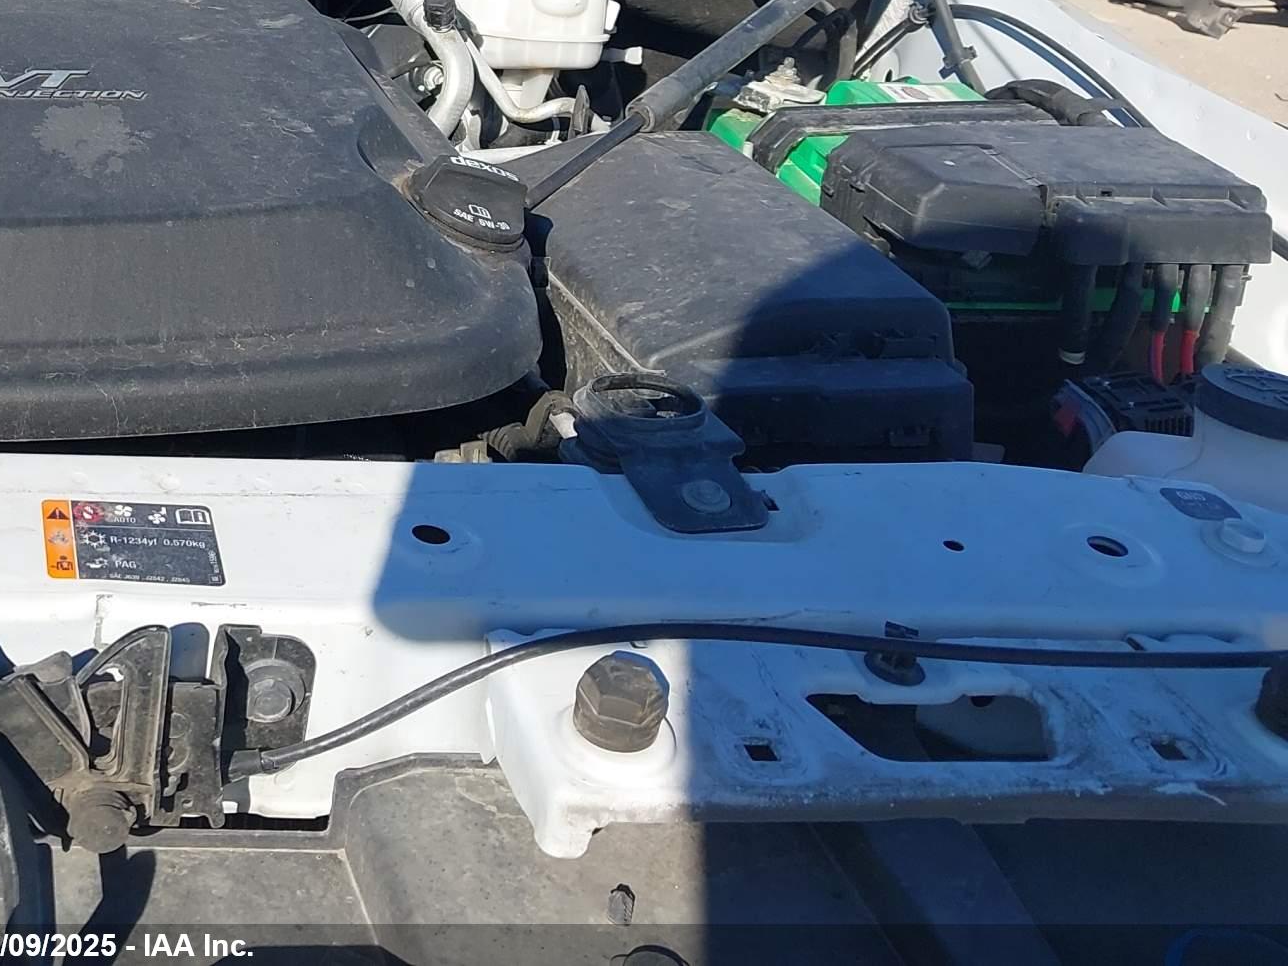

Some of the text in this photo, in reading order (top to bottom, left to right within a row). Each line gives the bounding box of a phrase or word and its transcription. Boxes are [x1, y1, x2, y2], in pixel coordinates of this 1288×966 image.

[450, 155, 520, 182] dexos
[453, 208, 474, 223] SAE
[110, 535, 206, 549] R-1234yf 0.570kg
[114, 559, 137, 570] PAG
